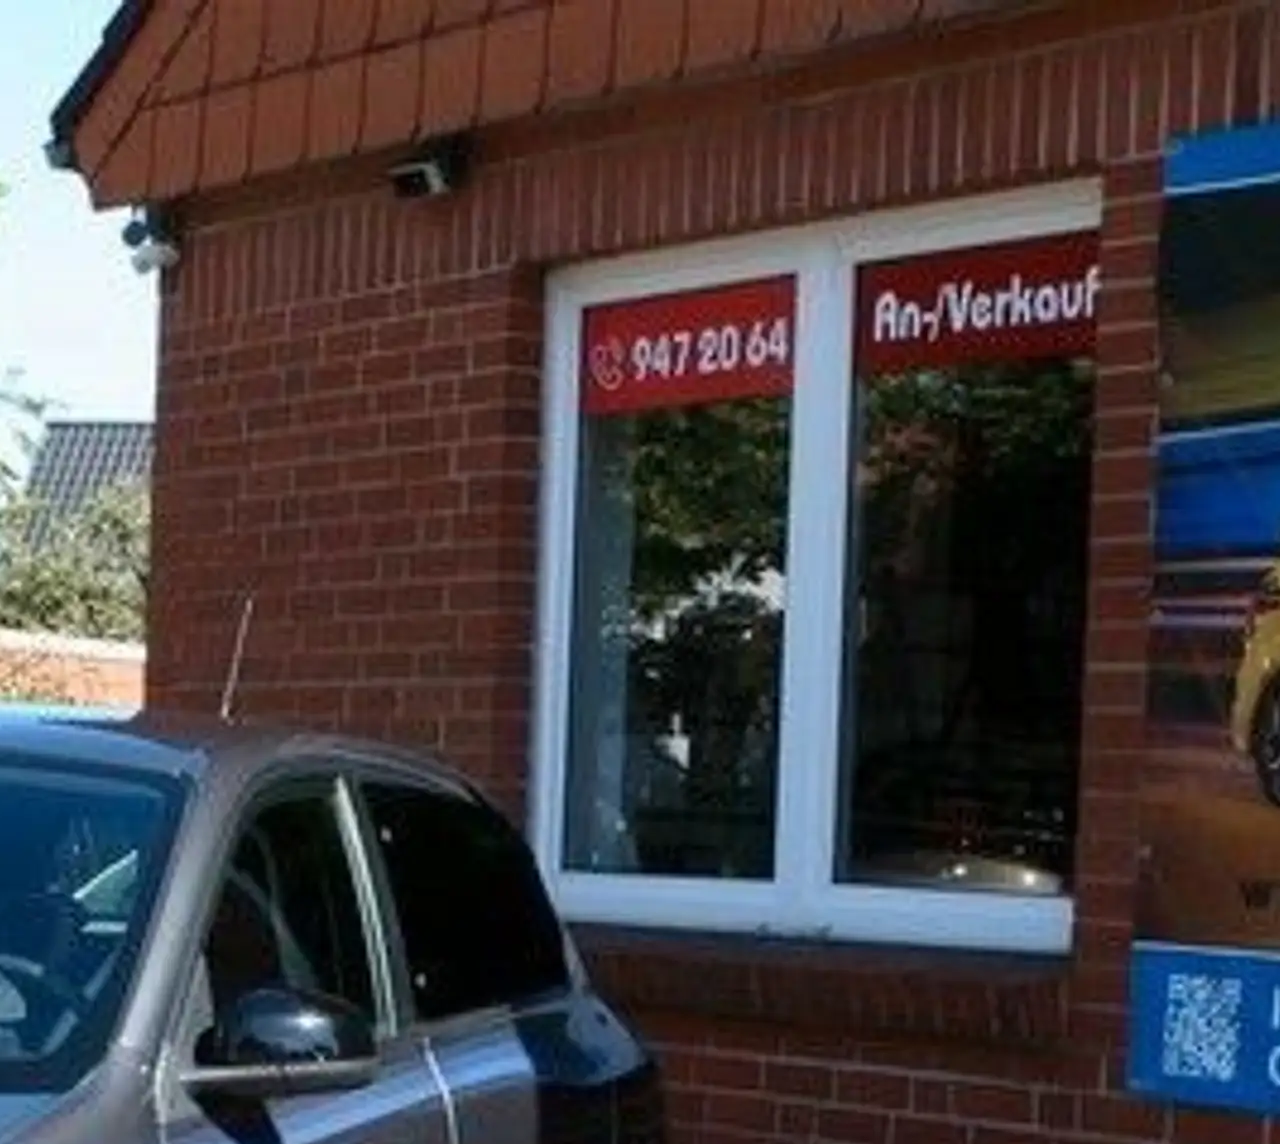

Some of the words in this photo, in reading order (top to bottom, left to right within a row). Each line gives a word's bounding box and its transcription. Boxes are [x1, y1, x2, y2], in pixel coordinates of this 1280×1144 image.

[873, 266, 1100, 343] An-/Verkauf
[631, 332, 689, 381] 947
[699, 328, 738, 375] 20
[747, 317, 789, 367] 64
